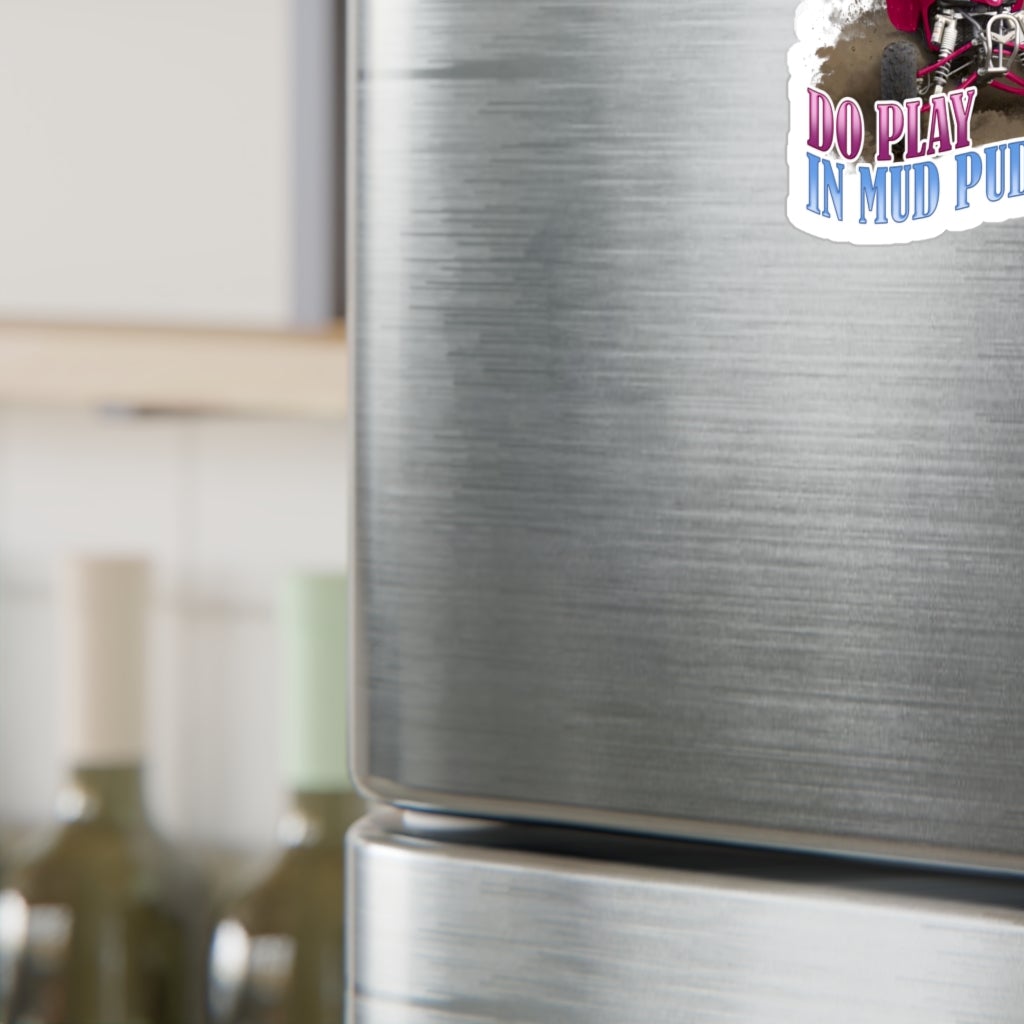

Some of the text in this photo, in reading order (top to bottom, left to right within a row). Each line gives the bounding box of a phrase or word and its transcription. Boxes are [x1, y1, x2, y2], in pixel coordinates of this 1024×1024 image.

[806, 87, 976, 161] DO PLAY
[806, 152, 844, 221] IN
[858, 161, 940, 224] MUD
